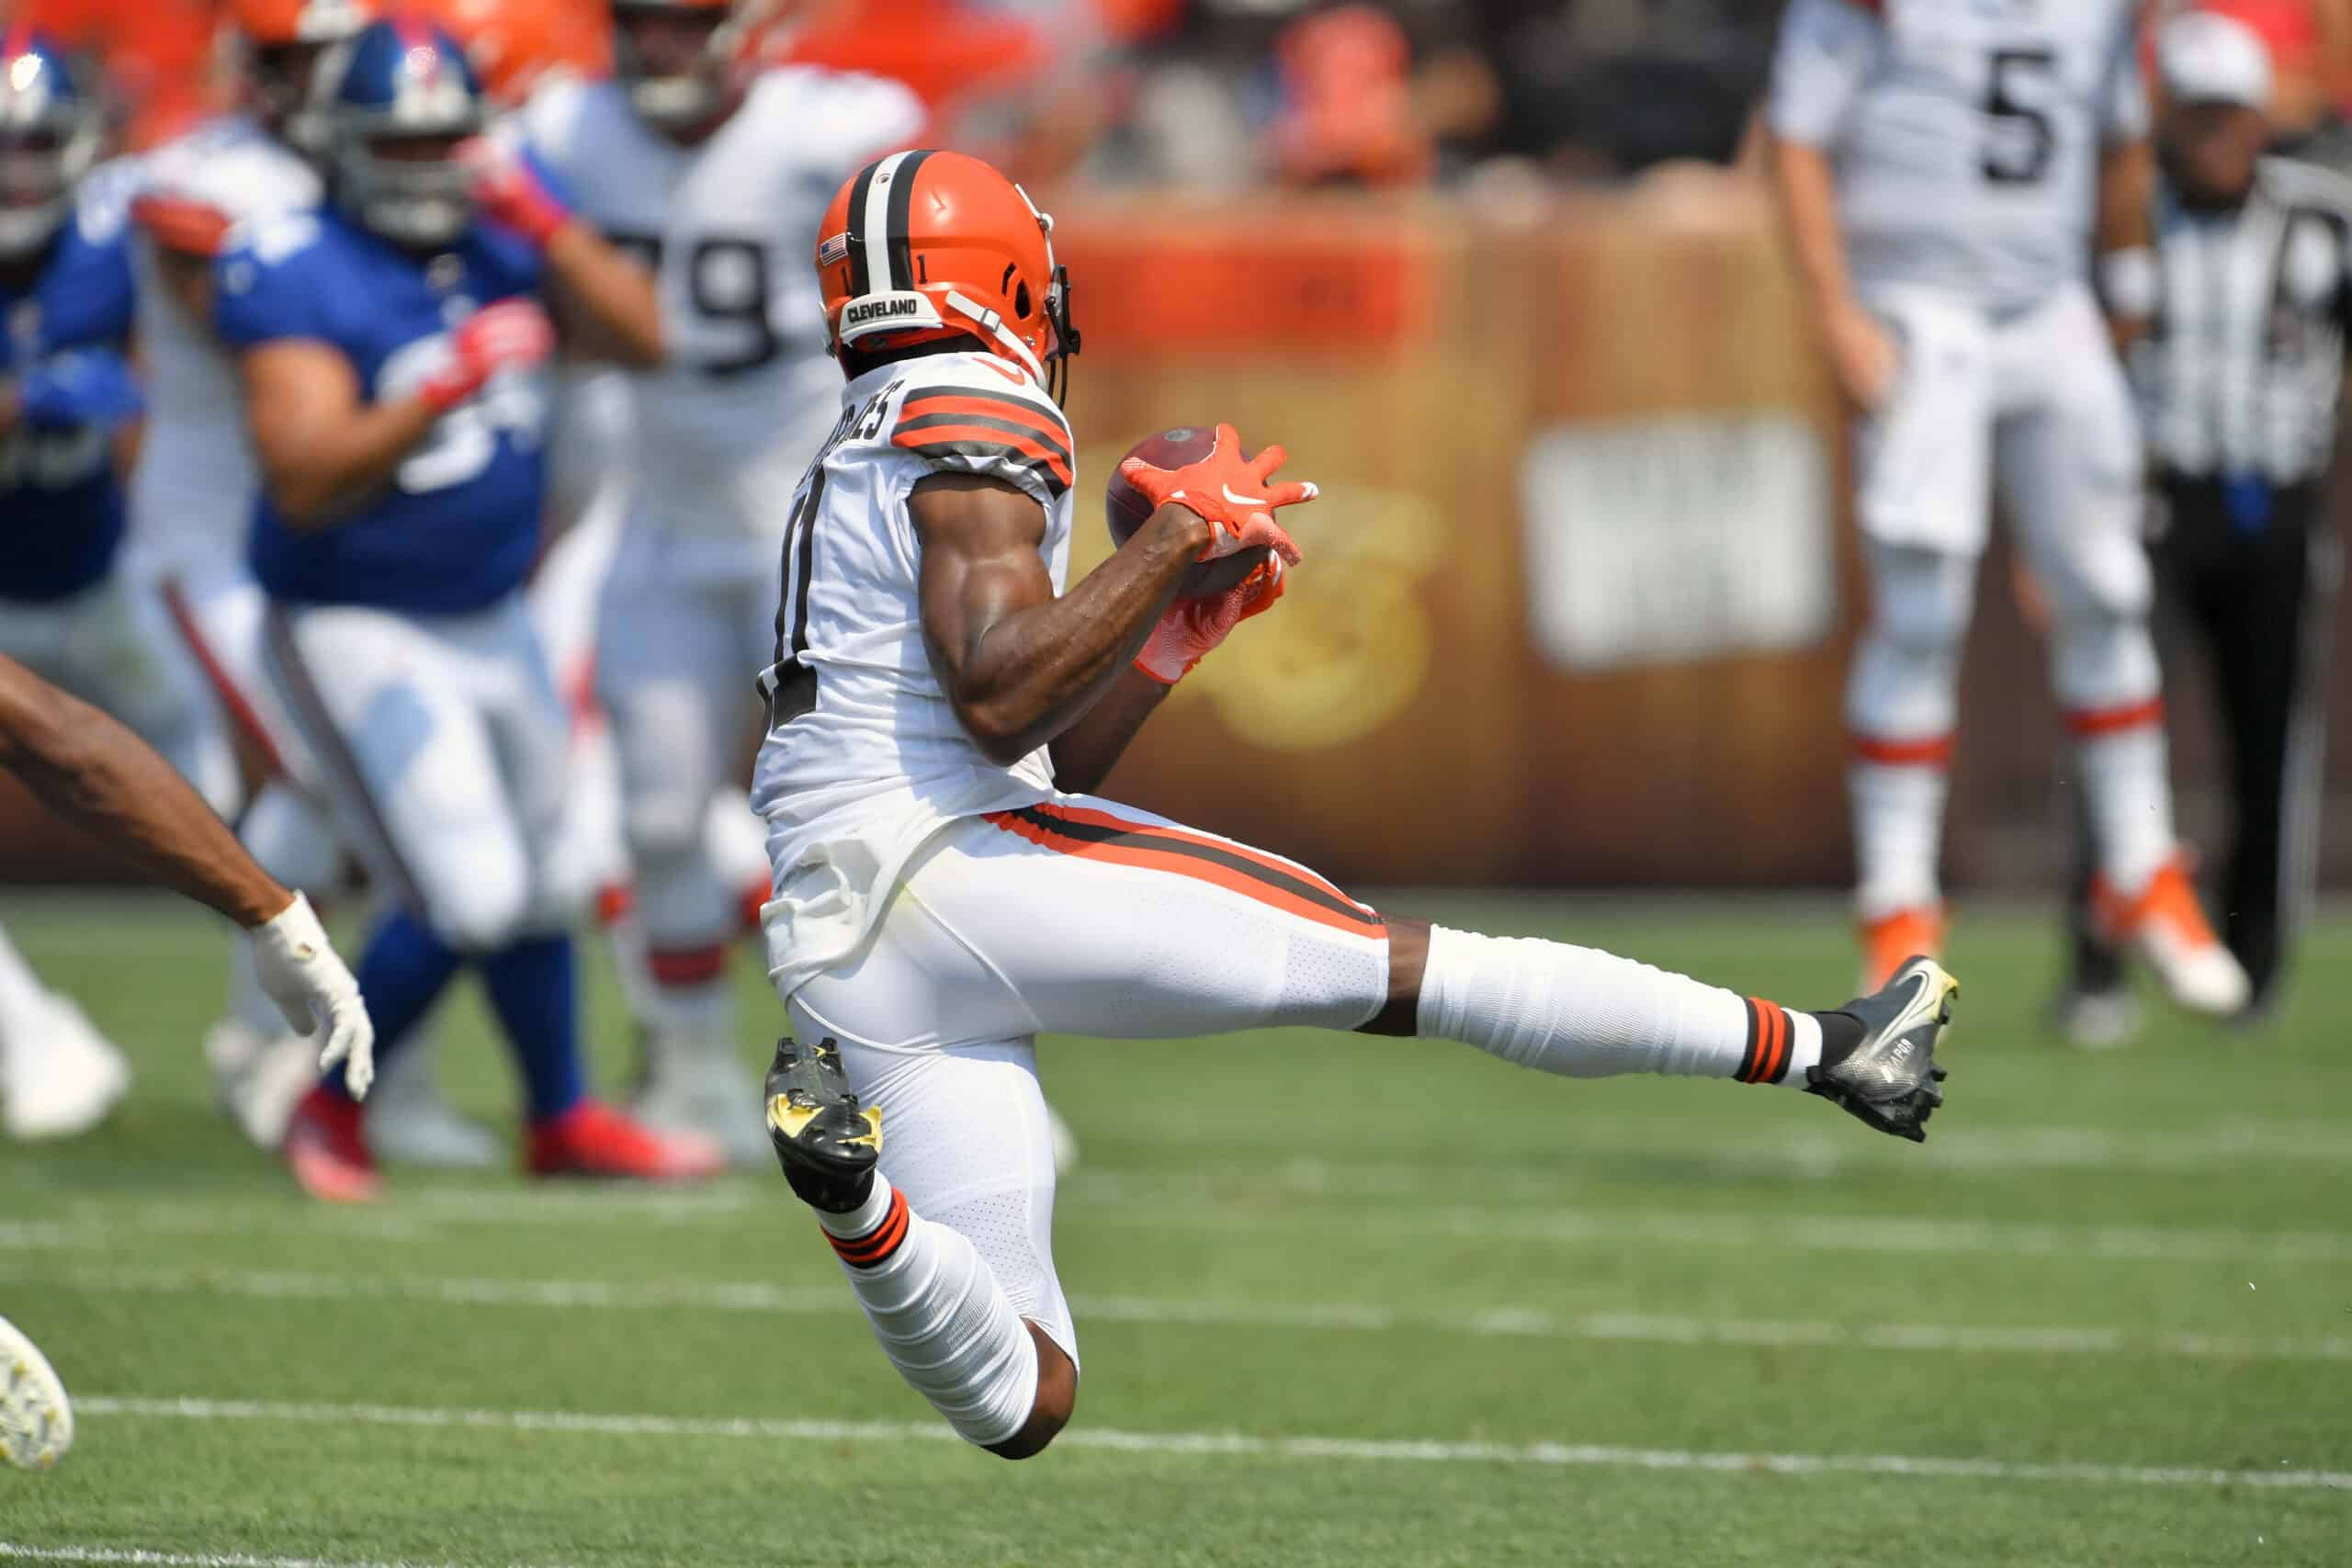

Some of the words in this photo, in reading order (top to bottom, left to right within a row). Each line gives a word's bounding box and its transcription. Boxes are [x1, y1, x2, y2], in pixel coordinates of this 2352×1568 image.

[1976, 47, 2056, 186] 5
[917, 254, 927, 284] 1
[847, 299, 917, 322] CLEVELAND
